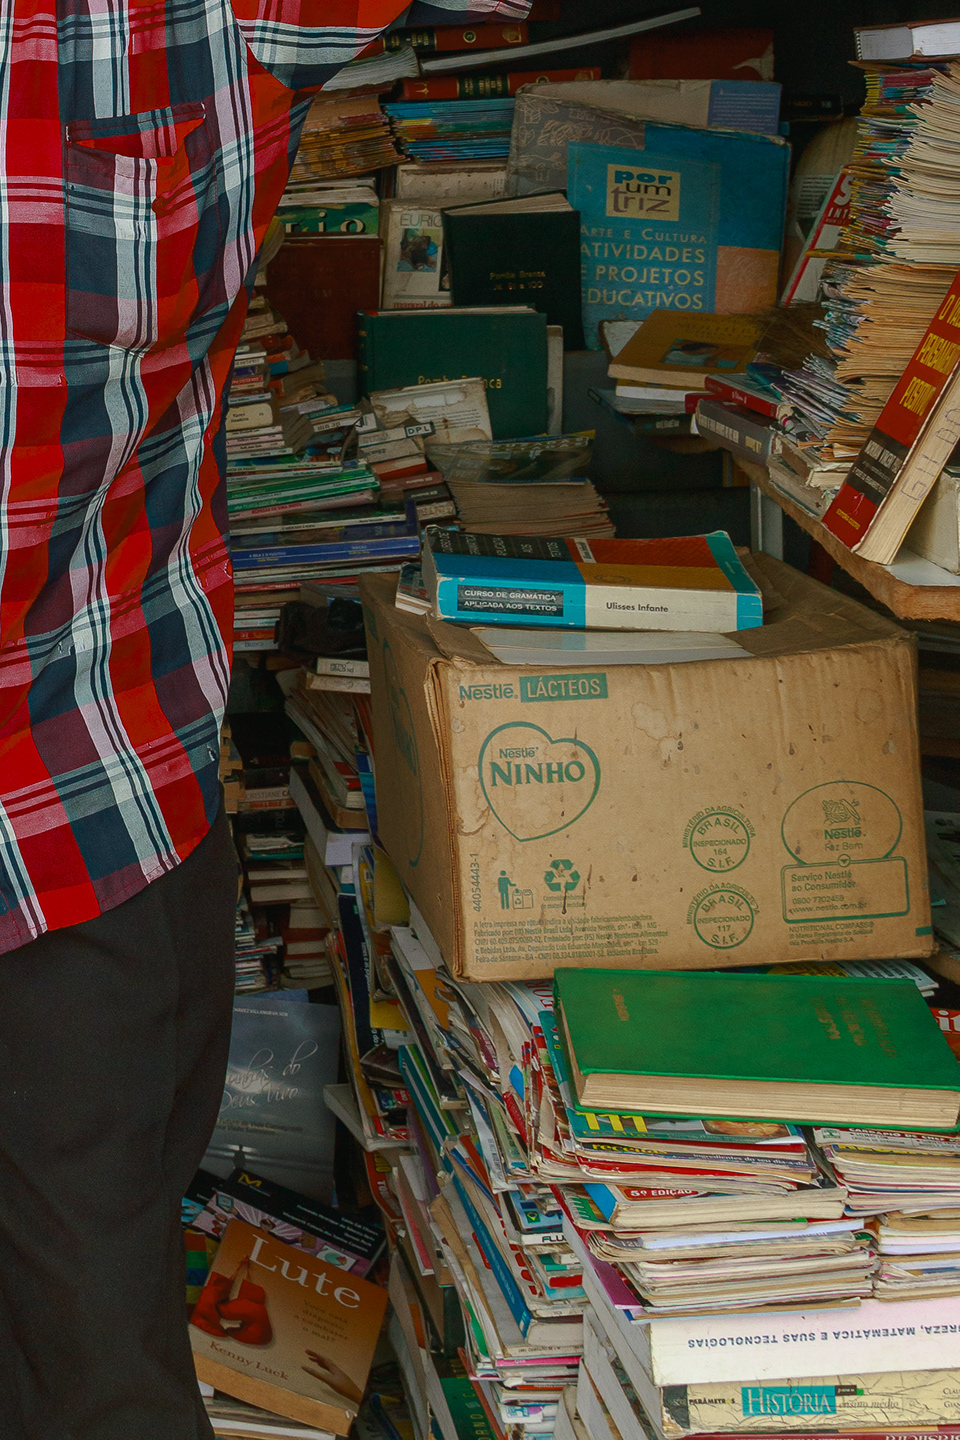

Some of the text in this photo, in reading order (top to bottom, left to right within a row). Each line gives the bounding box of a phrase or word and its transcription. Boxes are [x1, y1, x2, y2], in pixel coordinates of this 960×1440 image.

[615, 170, 672, 184] por
[626, 182, 671, 196] um
[611, 187, 670, 213] triz
[581, 242, 706, 264] ATIVIDADES
[596, 265, 705, 287] PROJETOS
[464, 590, 557, 602] CURSO DE GRAMÁTICA
[464, 601, 558, 613] APLICADA AOS TEXTOS
[606, 601, 670, 613] Ulisses Infante
[459, 676, 601, 701] Nestlé LÁCTEOS
[499, 747, 537, 759] Nestlé
[489, 760, 586, 788] NINHO
[697, 817, 742, 837] BRASIL
[824, 827, 862, 840] Nestlé
[693, 838, 747, 848] INSPECIONADO
[713, 848, 728, 856] 164
[470, 852, 482, 913] 44054443-1
[791, 870, 852, 883] Serviço Nestlé
[701, 895, 746, 913] BRASIL
[697, 915, 751, 924] INSPECIONADO
[247, 1234, 361, 1311] Lute
[687, 1326, 916, 1349] MATEMÁTICA E SUAS TECNOLOGIAS
[210, 1339, 290, 1381] Kenny Luck
[747, 1388, 832, 1416] HISTÓRIA
